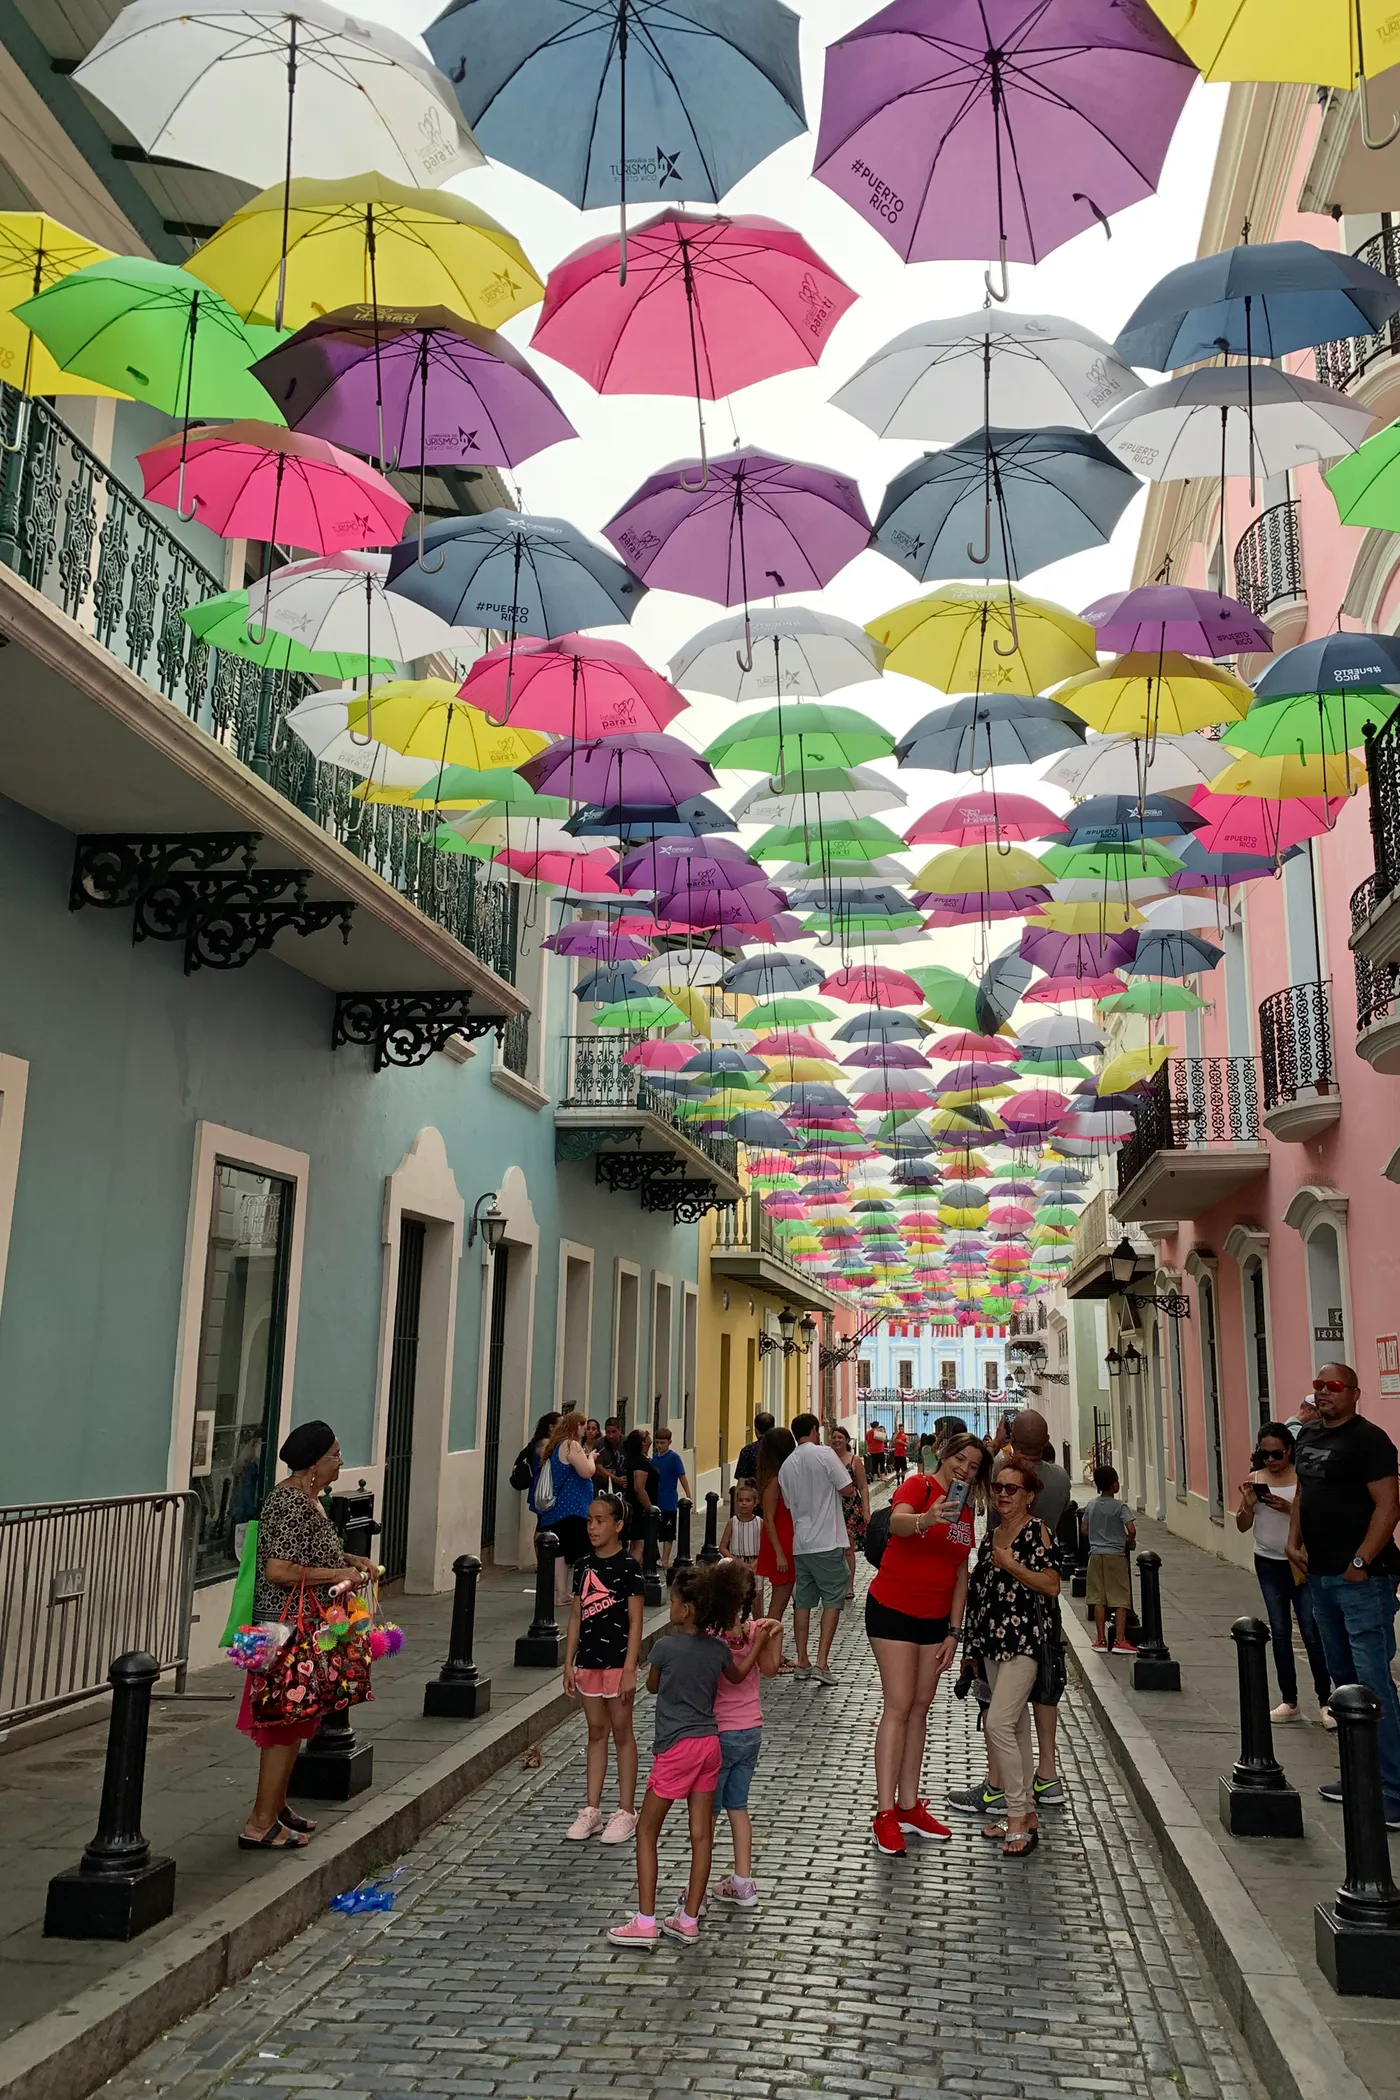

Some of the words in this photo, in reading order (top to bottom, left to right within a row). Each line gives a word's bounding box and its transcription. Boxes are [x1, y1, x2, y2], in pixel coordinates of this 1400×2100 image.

[422, 151, 448, 175] para
[609, 162, 657, 176] TURISMO
[851, 159, 904, 213] #PUERTO
[869, 193, 898, 224] RICO
[810, 309, 828, 337] para
[822, 296, 834, 309] ti
[1091, 388, 1112, 409] para
[1110, 378, 1121, 390] ti
[1118, 441, 1160, 458] #PUERTO
[1132, 453, 1155, 466] RICO
[618, 532, 636, 553] para
[476, 601, 529, 616] #PUERTO
[501, 612, 528, 624] RICO
[1217, 631, 1250, 642] #PUERTO
[1235, 637, 1254, 647] RICO
[602, 718, 626, 731] para
[628, 715, 637, 724] ti
[1085, 828, 1119, 836] #PUERTO
[1224, 835, 1258, 843] #PUERTO
[1239, 841, 1257, 849] RICO
[1317, 1330, 1344, 1338] FORT
[947, 1529, 972, 1547] RIC
